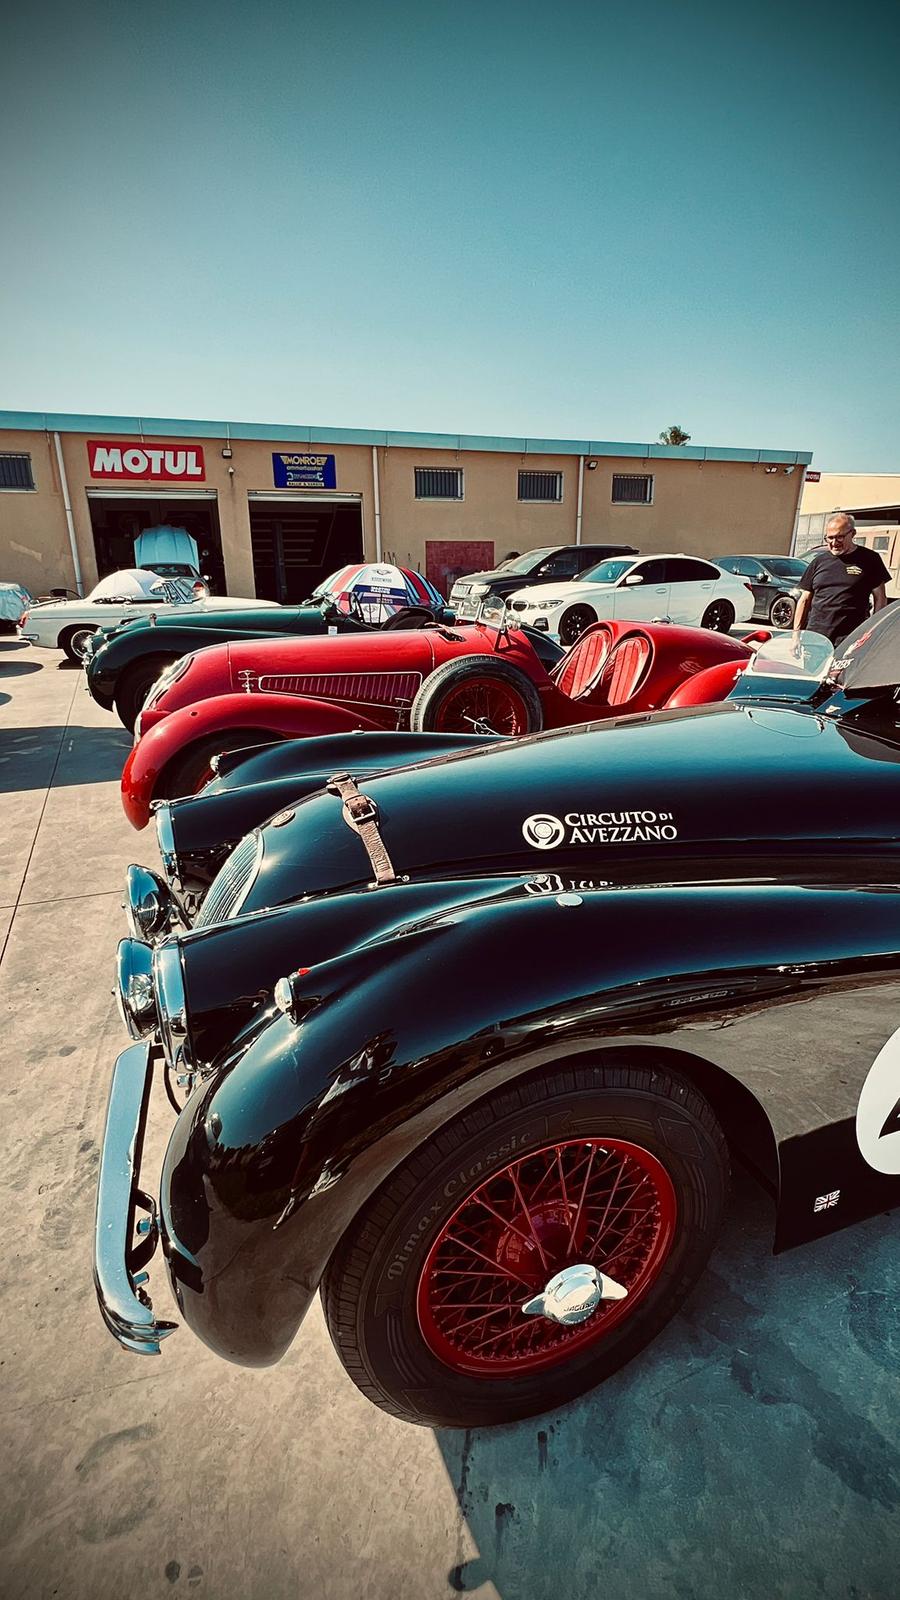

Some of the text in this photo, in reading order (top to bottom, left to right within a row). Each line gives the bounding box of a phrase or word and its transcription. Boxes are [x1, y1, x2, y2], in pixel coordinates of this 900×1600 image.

[93, 447, 202, 475] MOTUL
[283, 456, 326, 465] MONROE
[564, 810, 674, 827] CIRCUITO DI
[569, 825, 678, 844] AVEZZANO
[387, 1132, 531, 1280] Dimax Classic
